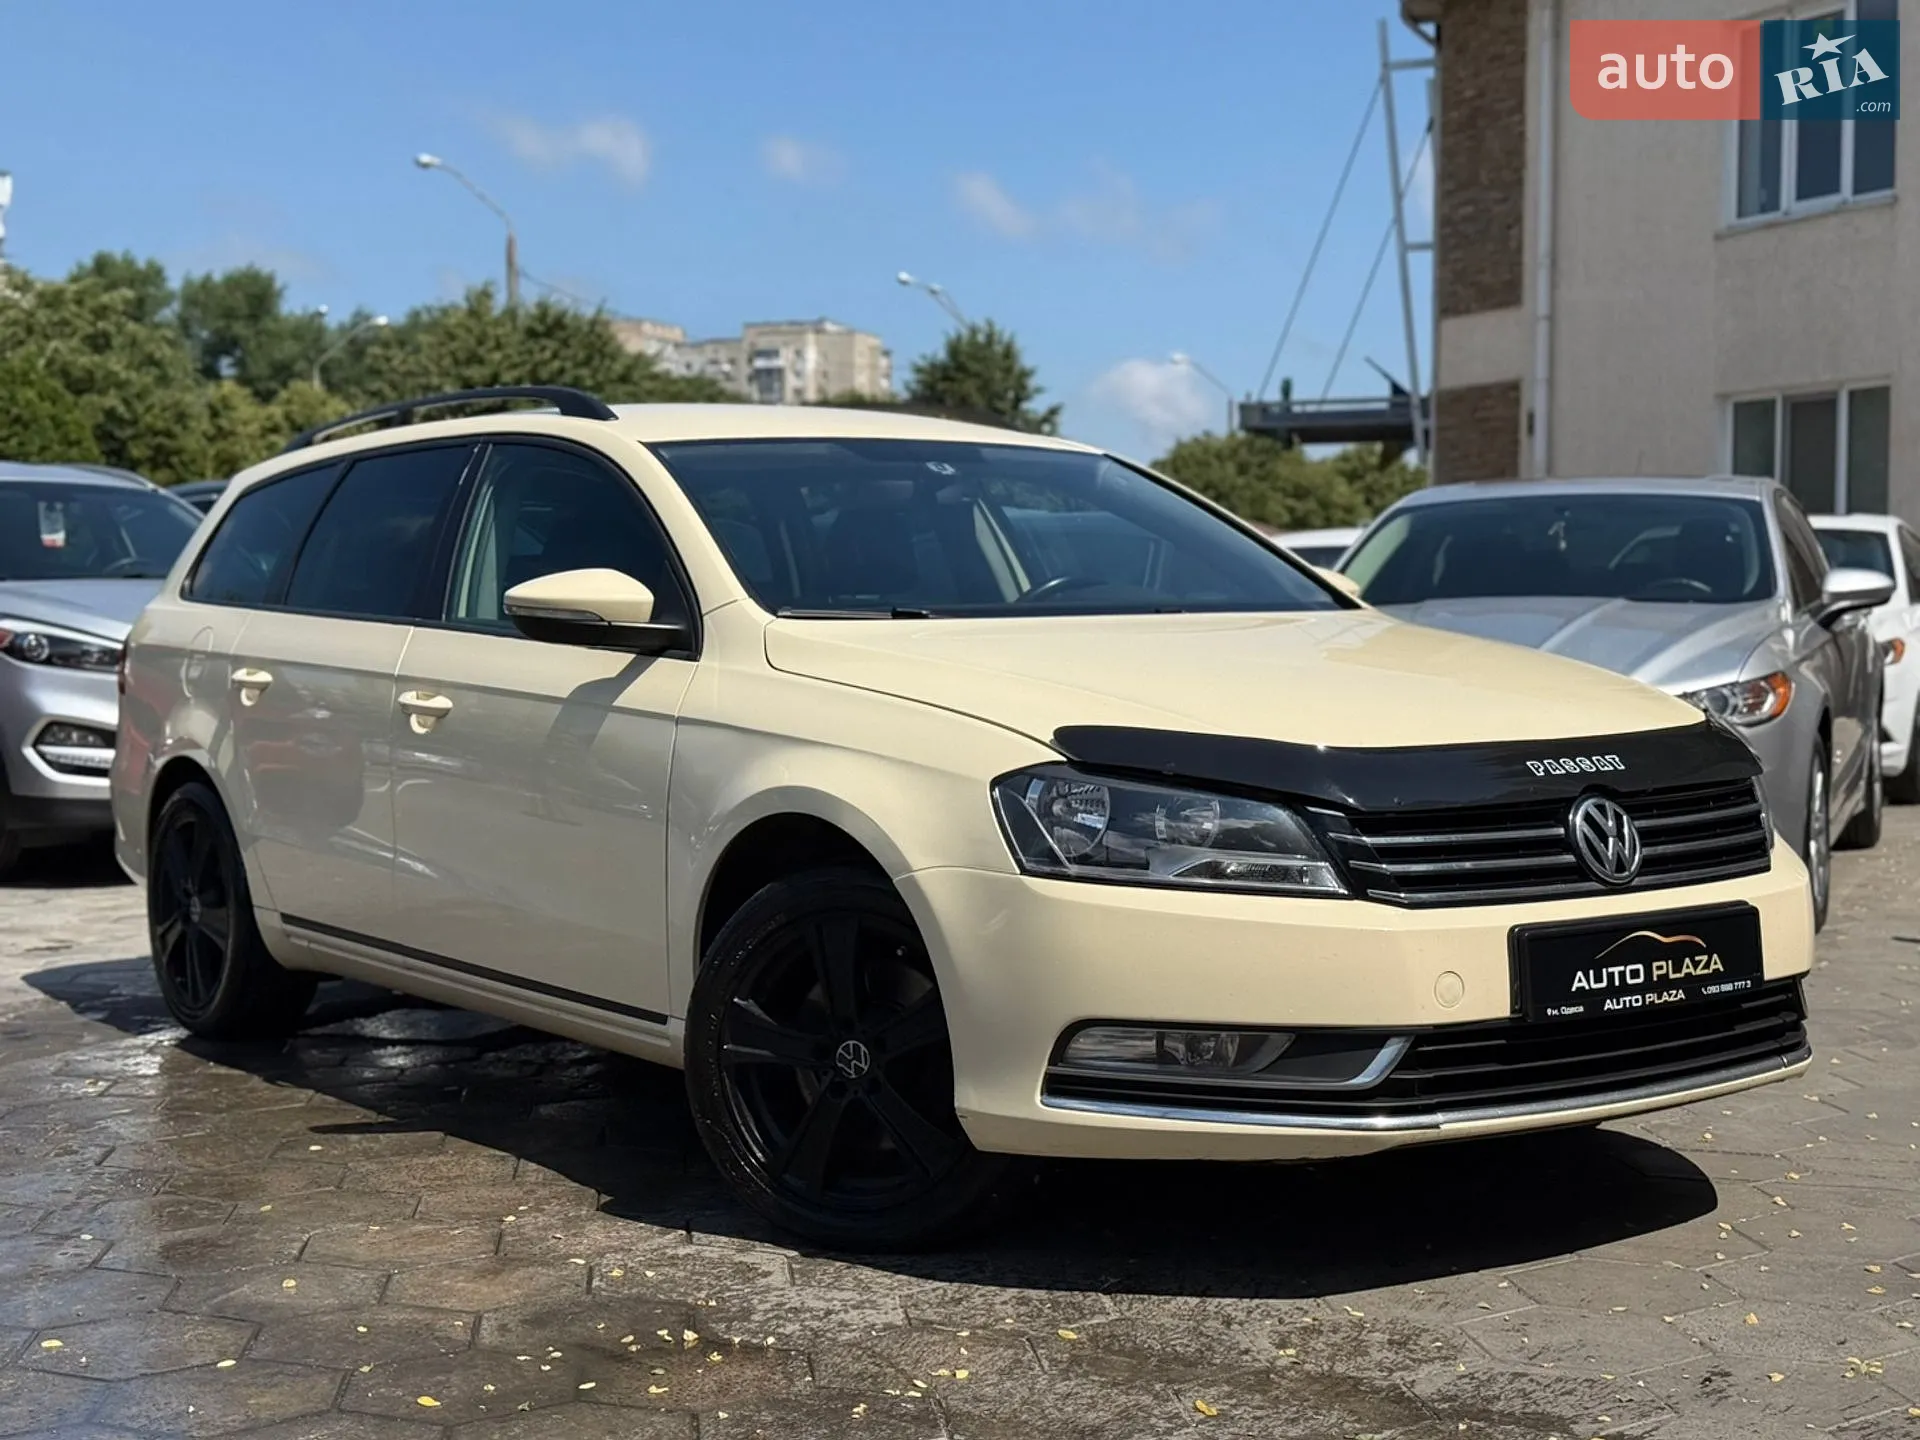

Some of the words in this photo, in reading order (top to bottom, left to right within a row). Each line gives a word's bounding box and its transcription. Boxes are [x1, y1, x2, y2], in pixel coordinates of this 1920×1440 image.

[1526, 755, 1626, 776] PASSAT
[1571, 964, 1645, 992] AUTO
[1652, 953, 1724, 982] PLAZA
[1603, 994, 1643, 1011] AUTO
[1645, 989, 1686, 1005] PLAZA
